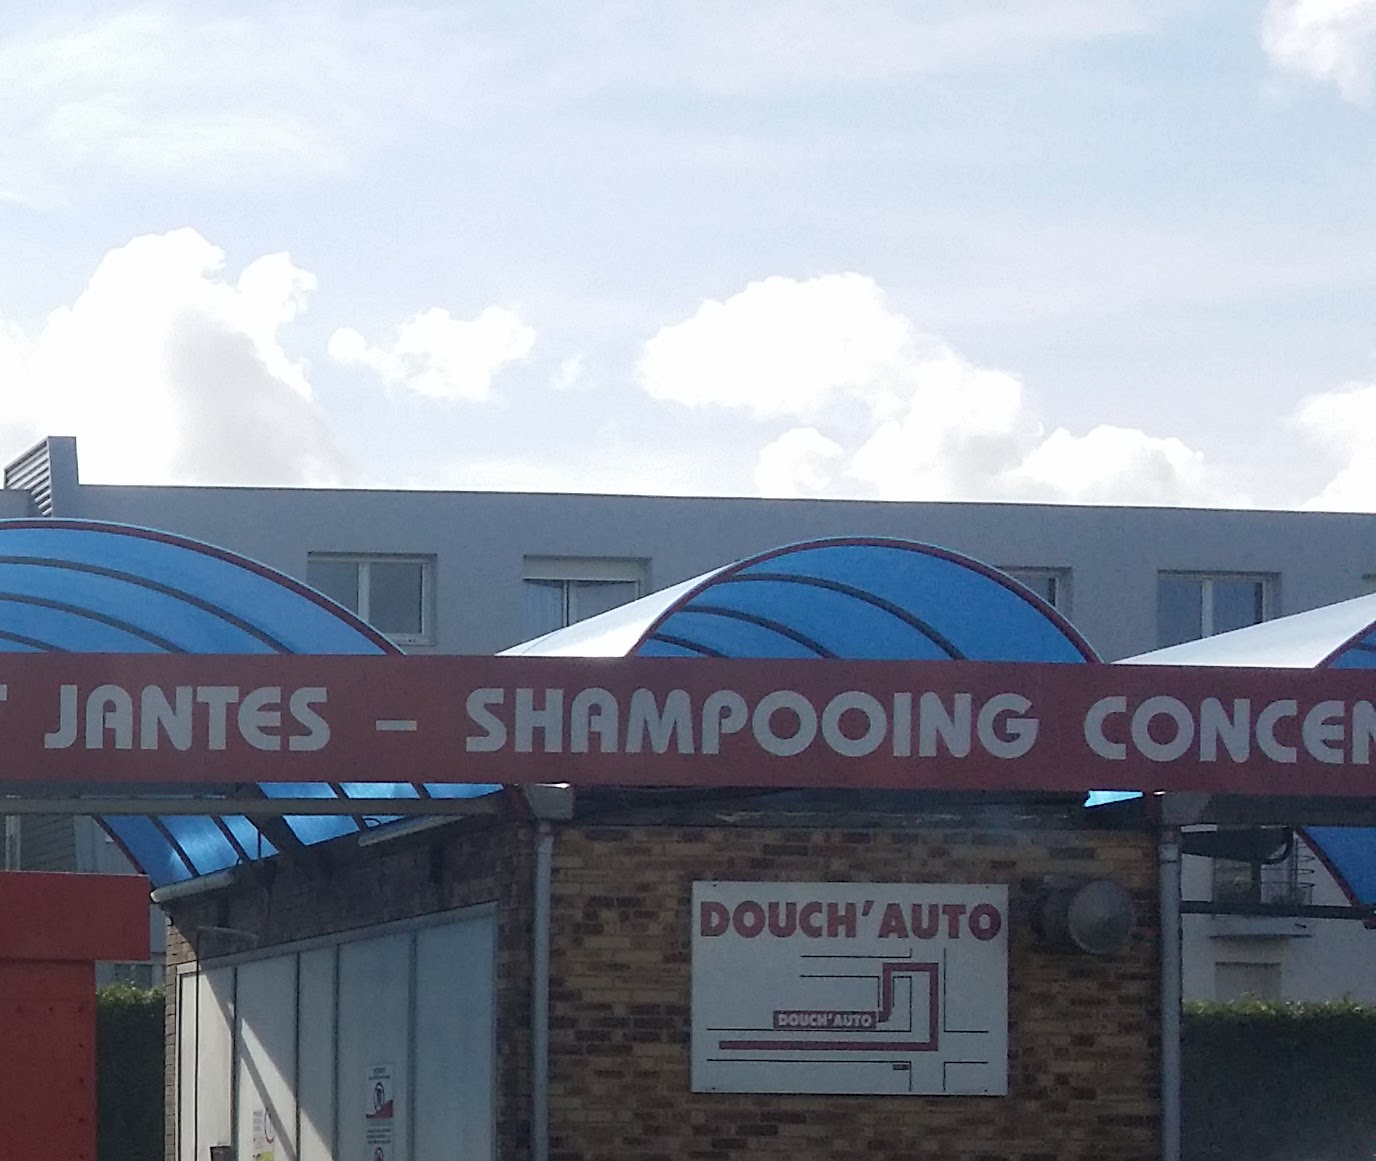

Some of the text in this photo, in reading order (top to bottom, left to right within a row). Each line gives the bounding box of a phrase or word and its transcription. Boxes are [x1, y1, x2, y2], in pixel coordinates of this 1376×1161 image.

[45, 685, 330, 752] JANTES
[465, 687, 1039, 760] SHAMPOOING
[700, 899, 1002, 941] DOUCH'AUTO
[777, 1012, 872, 1028] DOUCH'AUTO
